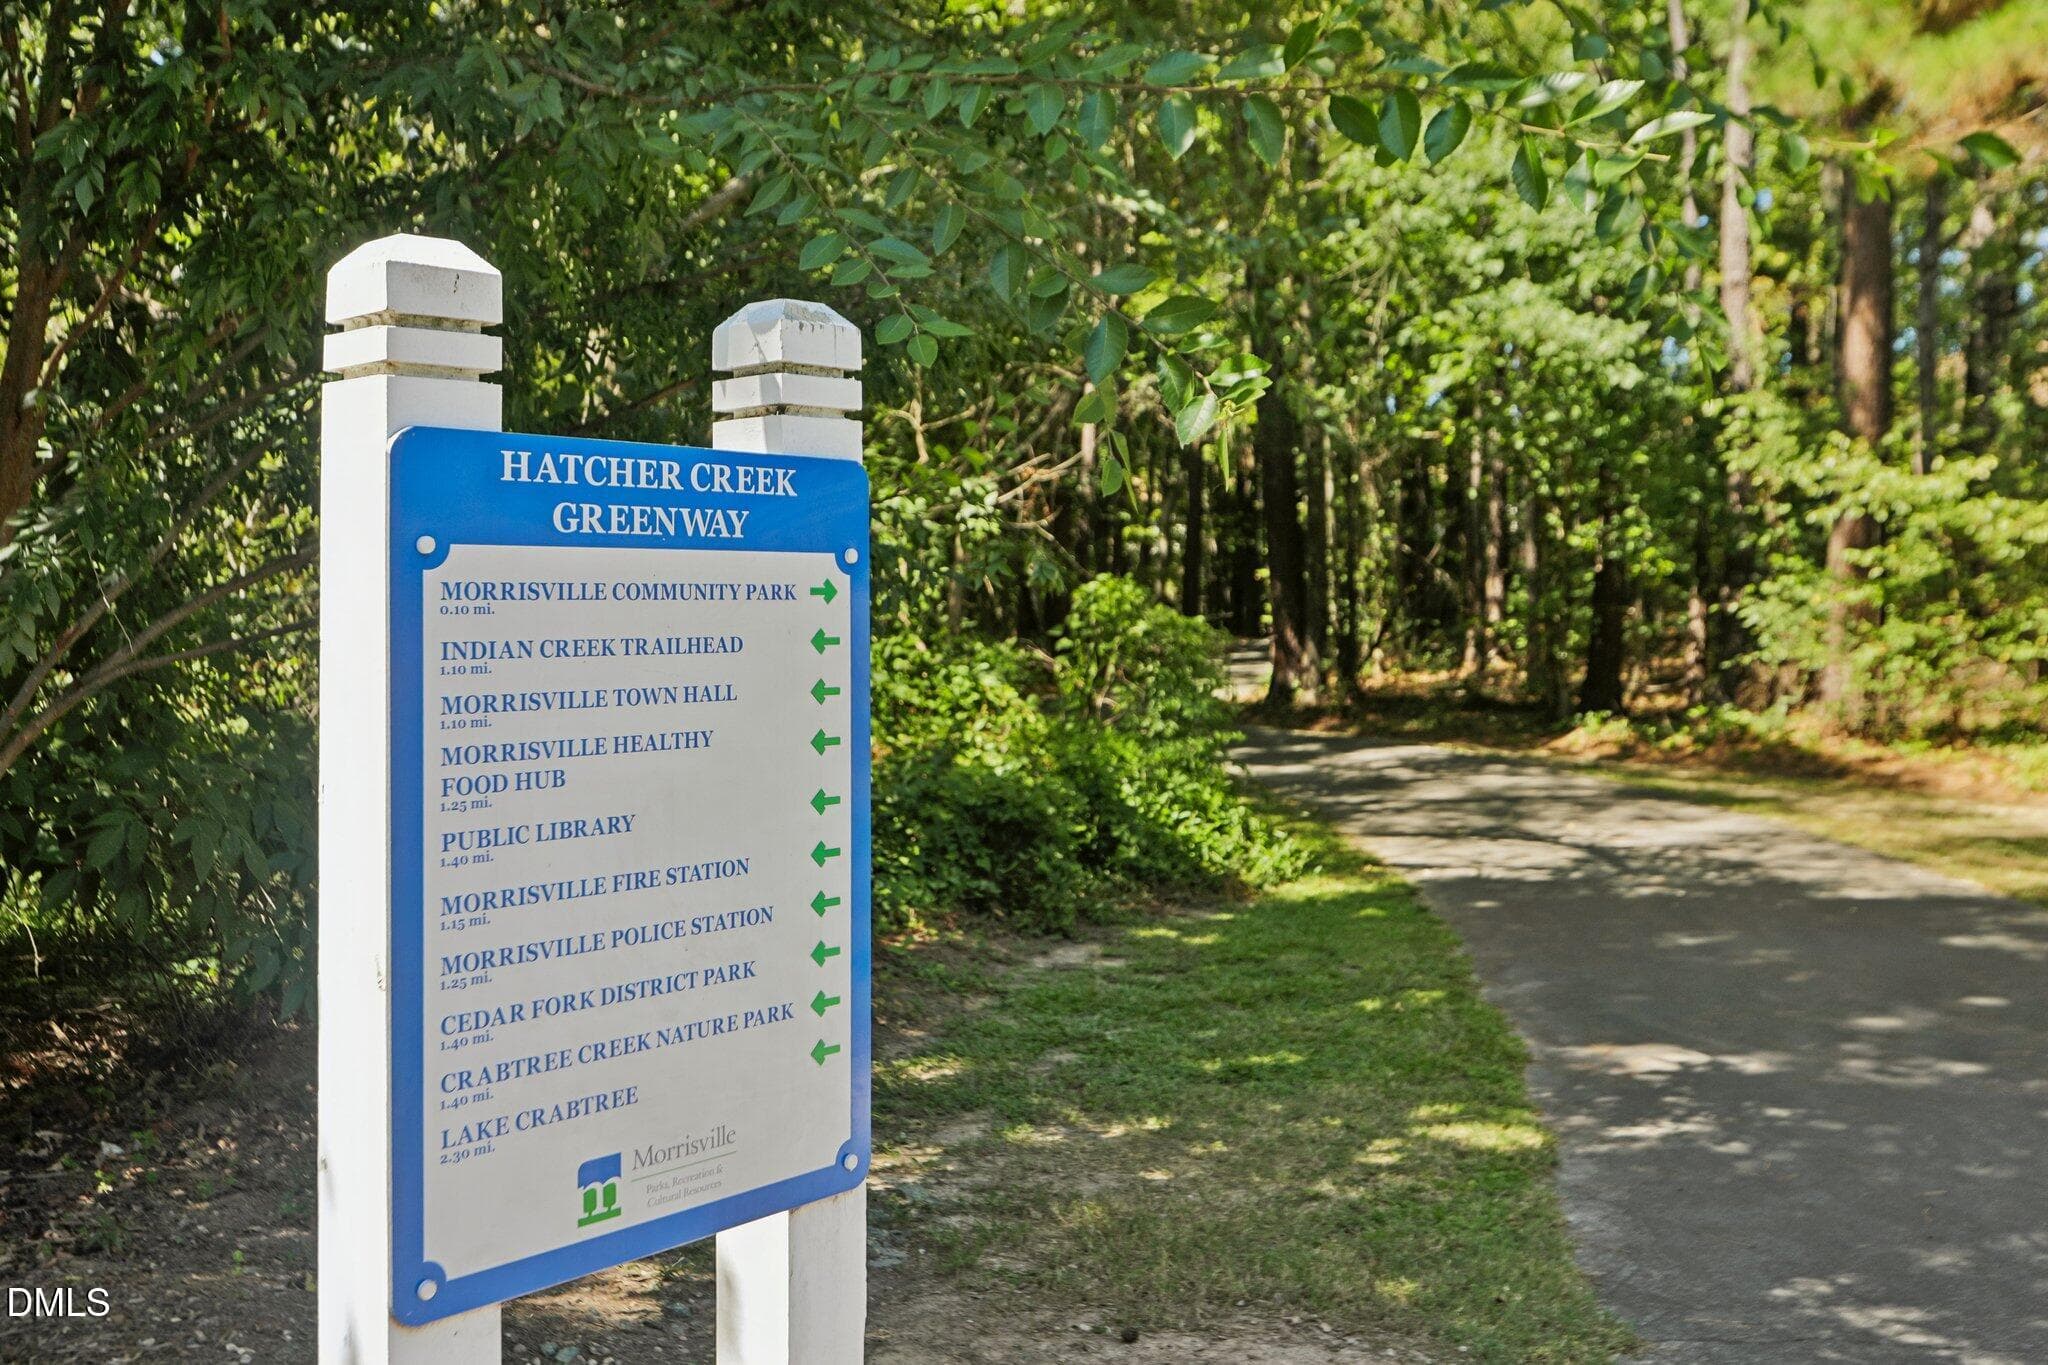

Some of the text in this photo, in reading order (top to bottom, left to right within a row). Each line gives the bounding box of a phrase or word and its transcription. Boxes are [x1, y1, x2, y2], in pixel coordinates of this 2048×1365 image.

[500, 450, 798, 497] HATCHER CREEK
[553, 502, 750, 538] GREENWAY
[440, 582, 797, 601] MORRISVILLE COMMUNITY PARK
[440, 603, 494, 615] 0.10 mi.
[440, 636, 743, 660] INDIAN CREEK TRAILHEAD
[440, 662, 492, 675] 1.10 mi.
[441, 684, 737, 715] MORRISVILLE TOWN HALL
[440, 715, 492, 729] 1.10 mi.
[441, 730, 714, 766] MORRISVILLE HEALTHY
[441, 770, 566, 797] FOOD HUB
[441, 795, 492, 812] 1.25 mi.
[442, 814, 636, 852] PUBLIC LIBRARY
[441, 850, 494, 868] 1.40 mi.
[440, 858, 750, 916] MORRISVILLE FIRE STATION
[441, 913, 490, 931] 1.15 mi.
[441, 906, 773, 976] MORRISVILLE POLICE STATION
[441, 971, 492, 990] 1.25 mi.
[441, 961, 756, 1035] CEDAR FORK DISTRICT PARK
[441, 1029, 494, 1051] 1.40 mi.
[441, 1003, 794, 1093] CRABTREE CREEK NATURE PARK
[440, 1088, 493, 1110] 1.40 mi.
[441, 1086, 638, 1149] LAKE CRABTREE
[440, 1140, 495, 1164] 2.30 mi.
[632, 1125, 736, 1171] Morrisville
[646, 1164, 723, 1194] Parks, Recreation &
[647, 1181, 722, 1207] Cultural Resources
